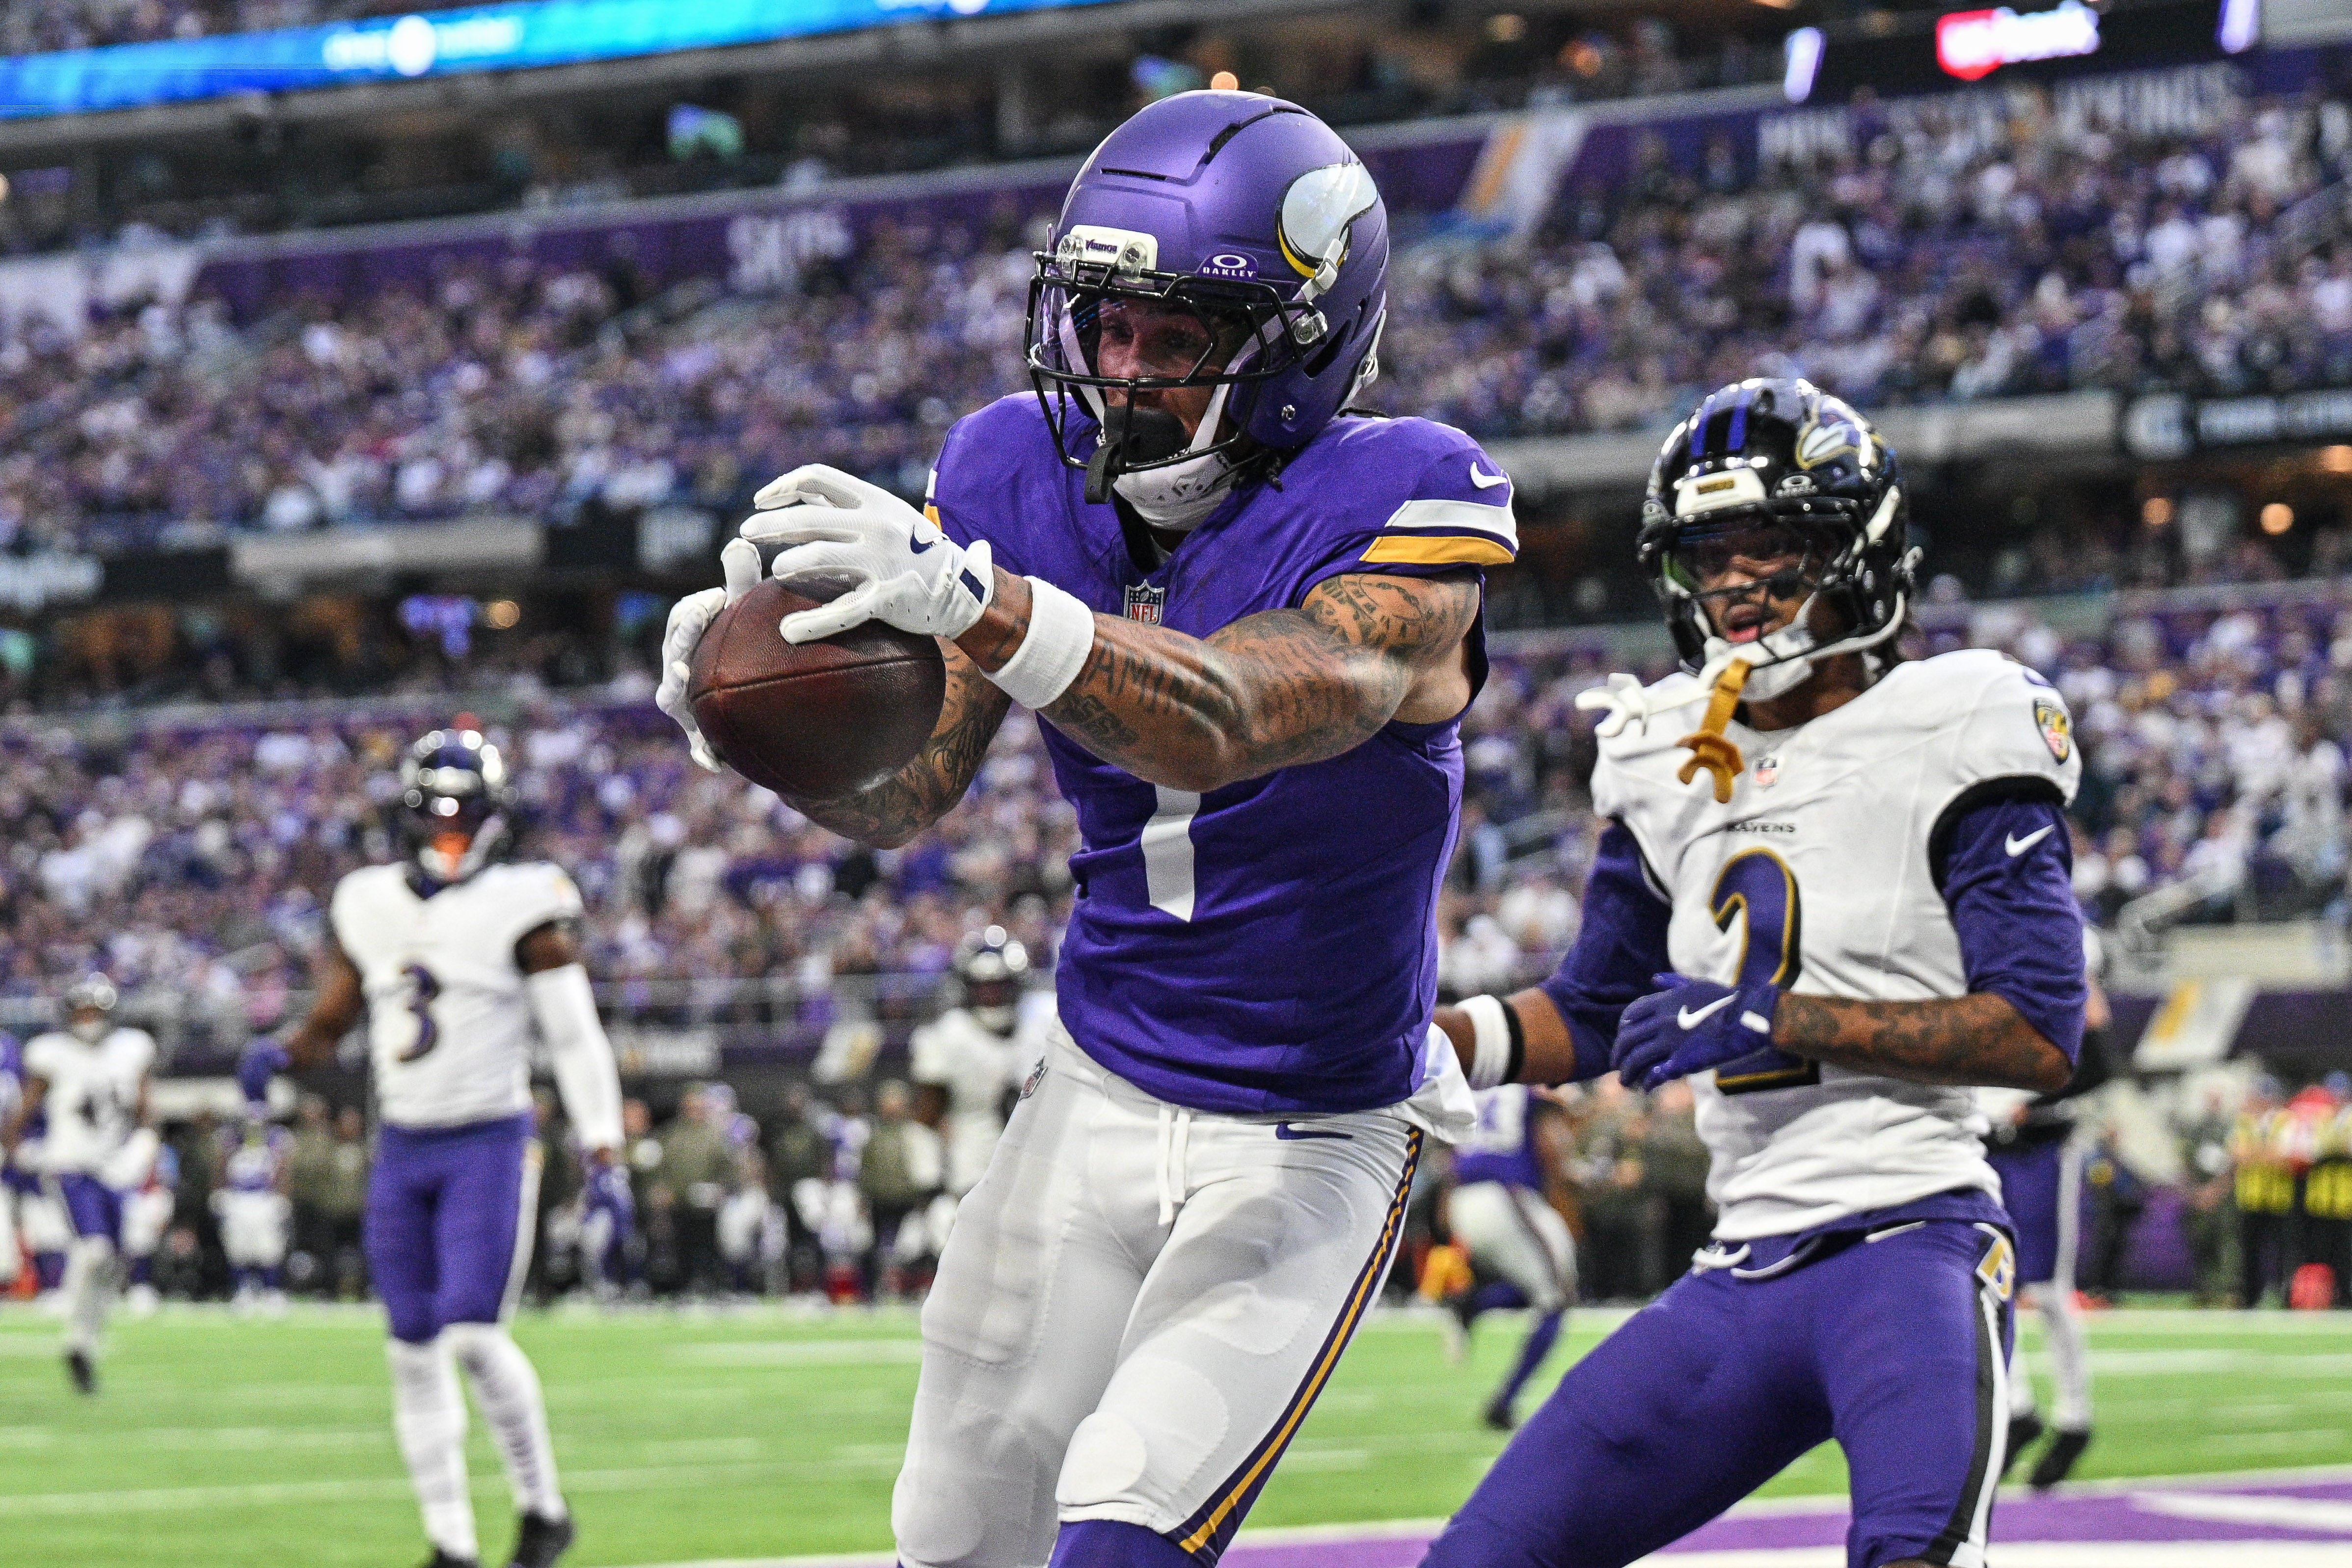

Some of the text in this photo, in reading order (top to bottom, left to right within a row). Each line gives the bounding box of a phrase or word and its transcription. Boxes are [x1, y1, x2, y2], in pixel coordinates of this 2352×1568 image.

[1203, 267, 1254, 277] OAKLEY
[1131, 604, 1157, 622] NFL
[1707, 845, 1820, 1095] 2
[397, 955, 443, 1064] 3
